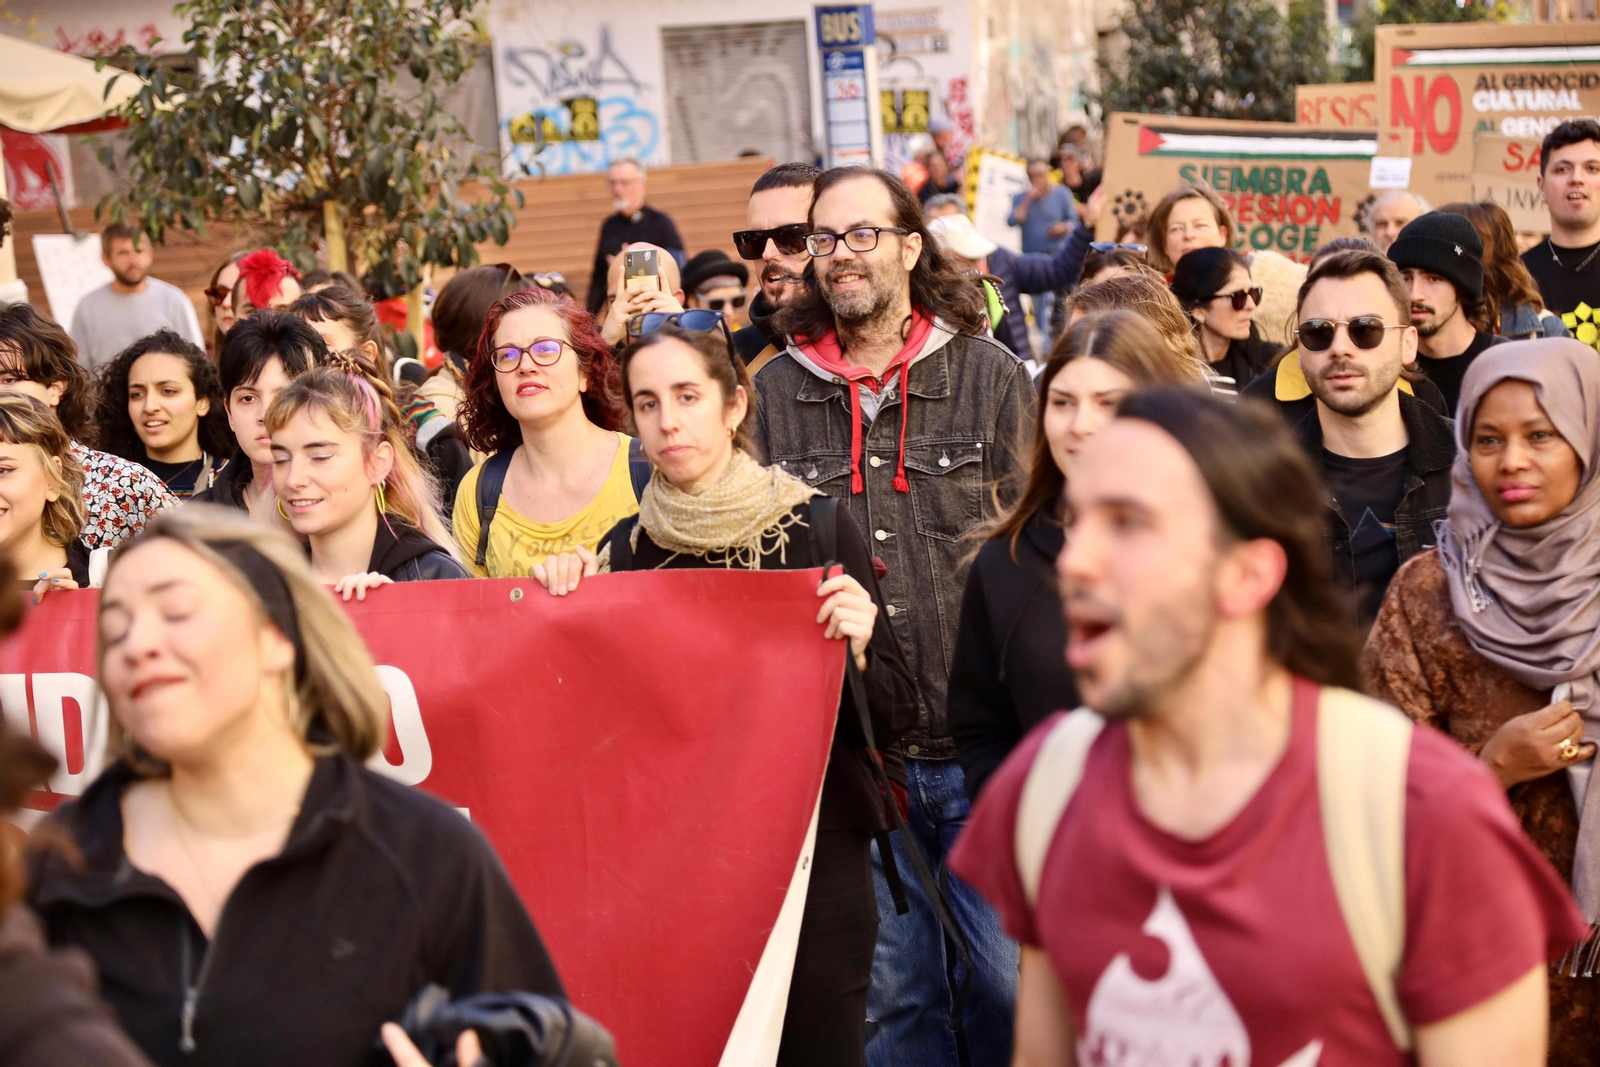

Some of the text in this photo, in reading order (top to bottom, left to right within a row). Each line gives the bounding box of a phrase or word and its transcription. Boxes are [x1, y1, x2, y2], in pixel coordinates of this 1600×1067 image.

[821, 11, 861, 43] BUS
[1391, 75, 1462, 155] NO
[1472, 88, 1583, 113] CULTURAL
[1180, 164, 1332, 195] SIEMBRA
[1506, 187, 1549, 211] INV
